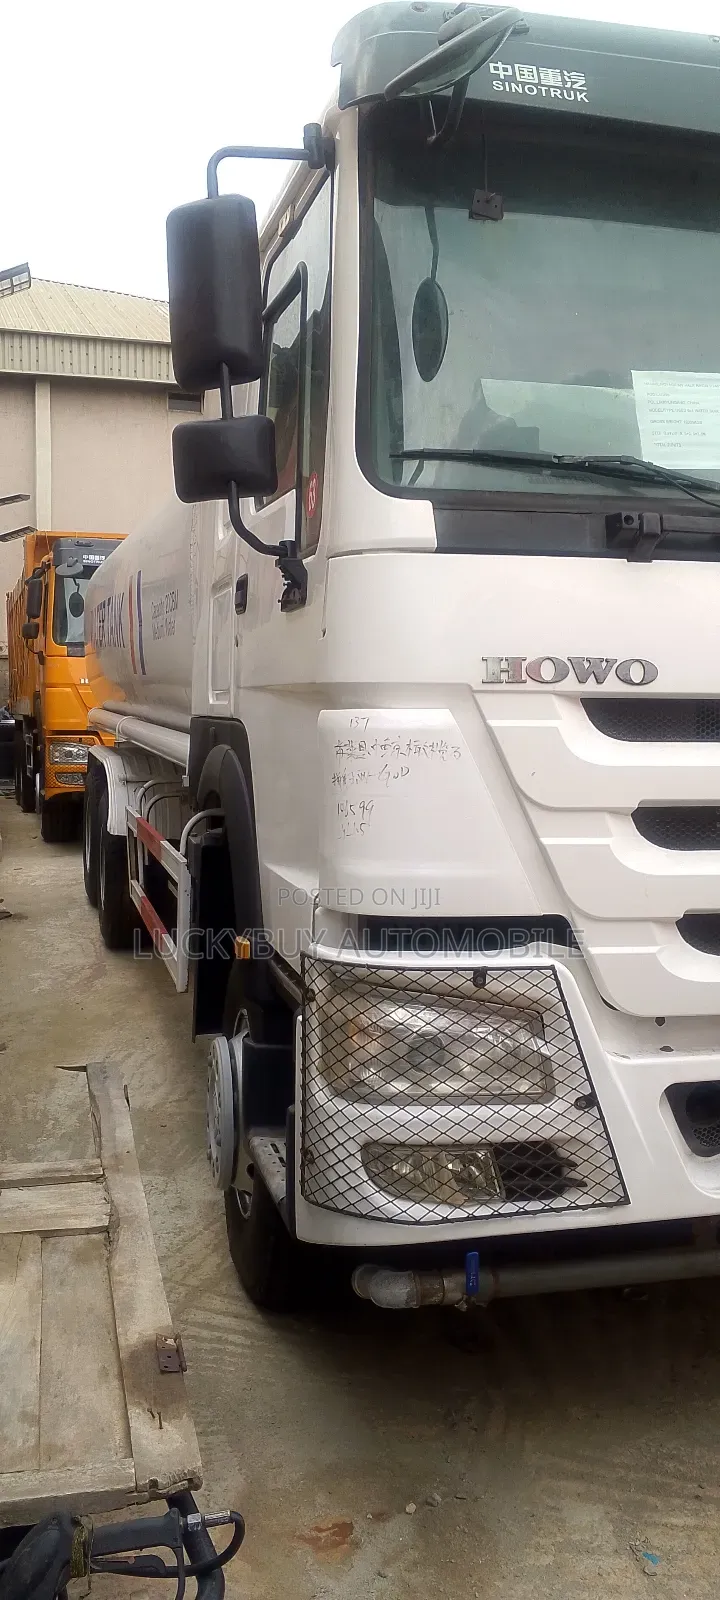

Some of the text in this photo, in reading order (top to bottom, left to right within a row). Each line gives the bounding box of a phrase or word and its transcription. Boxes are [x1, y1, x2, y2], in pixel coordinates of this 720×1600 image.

[489, 61, 587, 90] 中国重汽
[492, 80, 590, 103] SINOTRUK
[481, 656, 659, 686] HOWO
